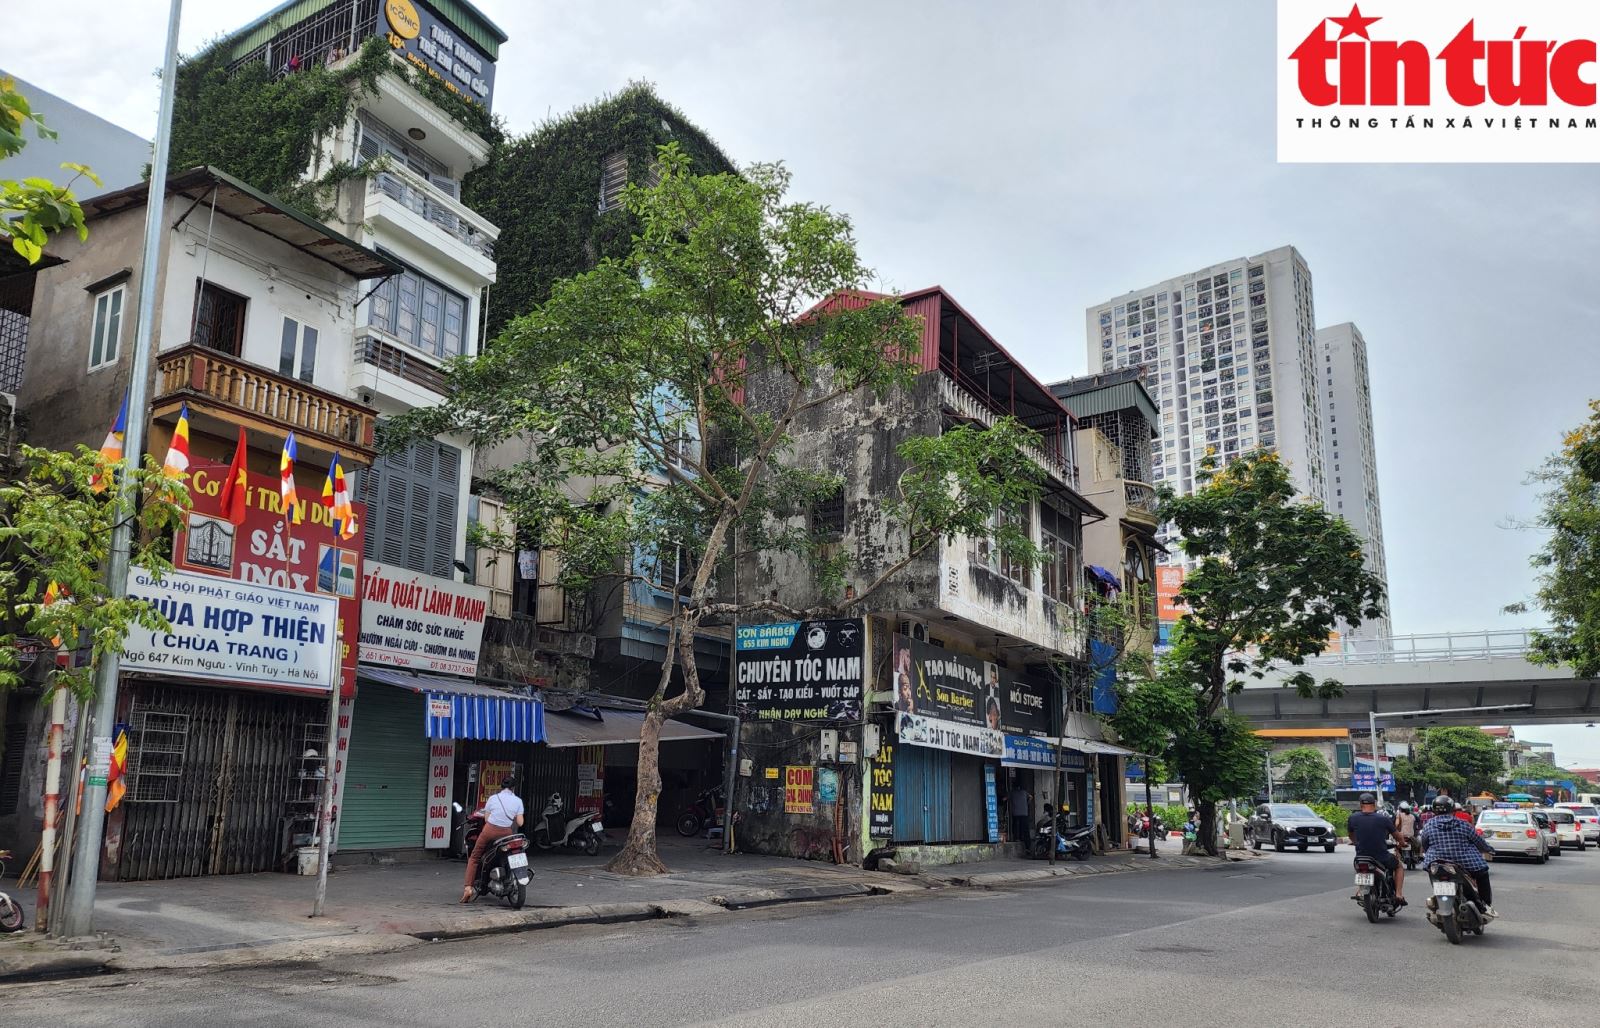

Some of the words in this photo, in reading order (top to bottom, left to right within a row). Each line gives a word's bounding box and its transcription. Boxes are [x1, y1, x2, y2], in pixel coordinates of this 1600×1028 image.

[389, 4, 418, 31] ICONIC
[431, 24, 454, 52] THỜI
[454, 42, 482, 75] TRANG
[418, 36, 438, 60] TRẺ
[436, 50, 453, 72] EM
[452, 62, 472, 86] CAO
[471, 77, 489, 98] CẤP
[192, 470, 221, 497] Cơ
[250, 520, 306, 565] SẮT
[172, 580, 195, 595] HỘI
[198, 585, 231, 600] PHẬT
[234, 591, 264, 604] GIÁO
[267, 596, 291, 609] VIỆT
[294, 601, 320, 613] NAM
[363, 566, 390, 604] TẨM
[391, 576, 423, 610] QUẤT
[454, 595, 486, 626] MẠNH
[203, 605, 254, 637] HỢP
[262, 615, 326, 647] THIỆN
[406, 619, 423, 633] SÓC
[425, 622, 442, 637] SỨC
[443, 626, 465, 640] KHỎE
[760, 625, 796, 638] BARBER
[163, 633, 220, 654] CHÙA
[226, 641, 289, 662] TRANG
[743, 638, 755, 648] 655
[756, 637, 770, 647] KIM
[121, 650, 145, 663] Ngõ
[148, 652, 169, 663] 647
[172, 654, 194, 666] Kim
[197, 658, 226, 671] Ngưu
[236, 662, 258, 673] Vĩnh
[303, 669, 319, 680] Nội
[379, 653, 392, 662] Kim
[462, 666, 475, 674] 6383
[458, 649, 476, 661] NÓNG
[738, 655, 792, 683] CHUYÊN
[795, 653, 822, 682] TÓC
[826, 656, 861, 681] NAM
[924, 659, 944, 680] TẠO
[944, 655, 965, 681] MẪU
[965, 667, 982, 690] TÓC
[757, 685, 773, 700] SẤY
[779, 688, 794, 702] TẠO
[795, 683, 814, 699] KIỂU
[821, 683, 842, 698] VUỐT
[951, 691, 974, 708] Barber
[1022, 693, 1043, 710] STORE
[758, 706, 782, 722] NHẬN
[784, 708, 802, 721] DẠY
[803, 704, 829, 718] NGHỀ
[945, 729, 961, 749] TÓC
[962, 734, 980, 752] NAM
[432, 745, 453, 760] MẠNH
[433, 765, 449, 780] CẠO
[787, 768, 813, 786] CƠM
[873, 765, 893, 787] TÓC
[433, 783, 446, 799] GIÓ
[430, 803, 448, 819] GIÁC
[871, 793, 893, 811] NAM
[431, 826, 445, 840] HƠI
